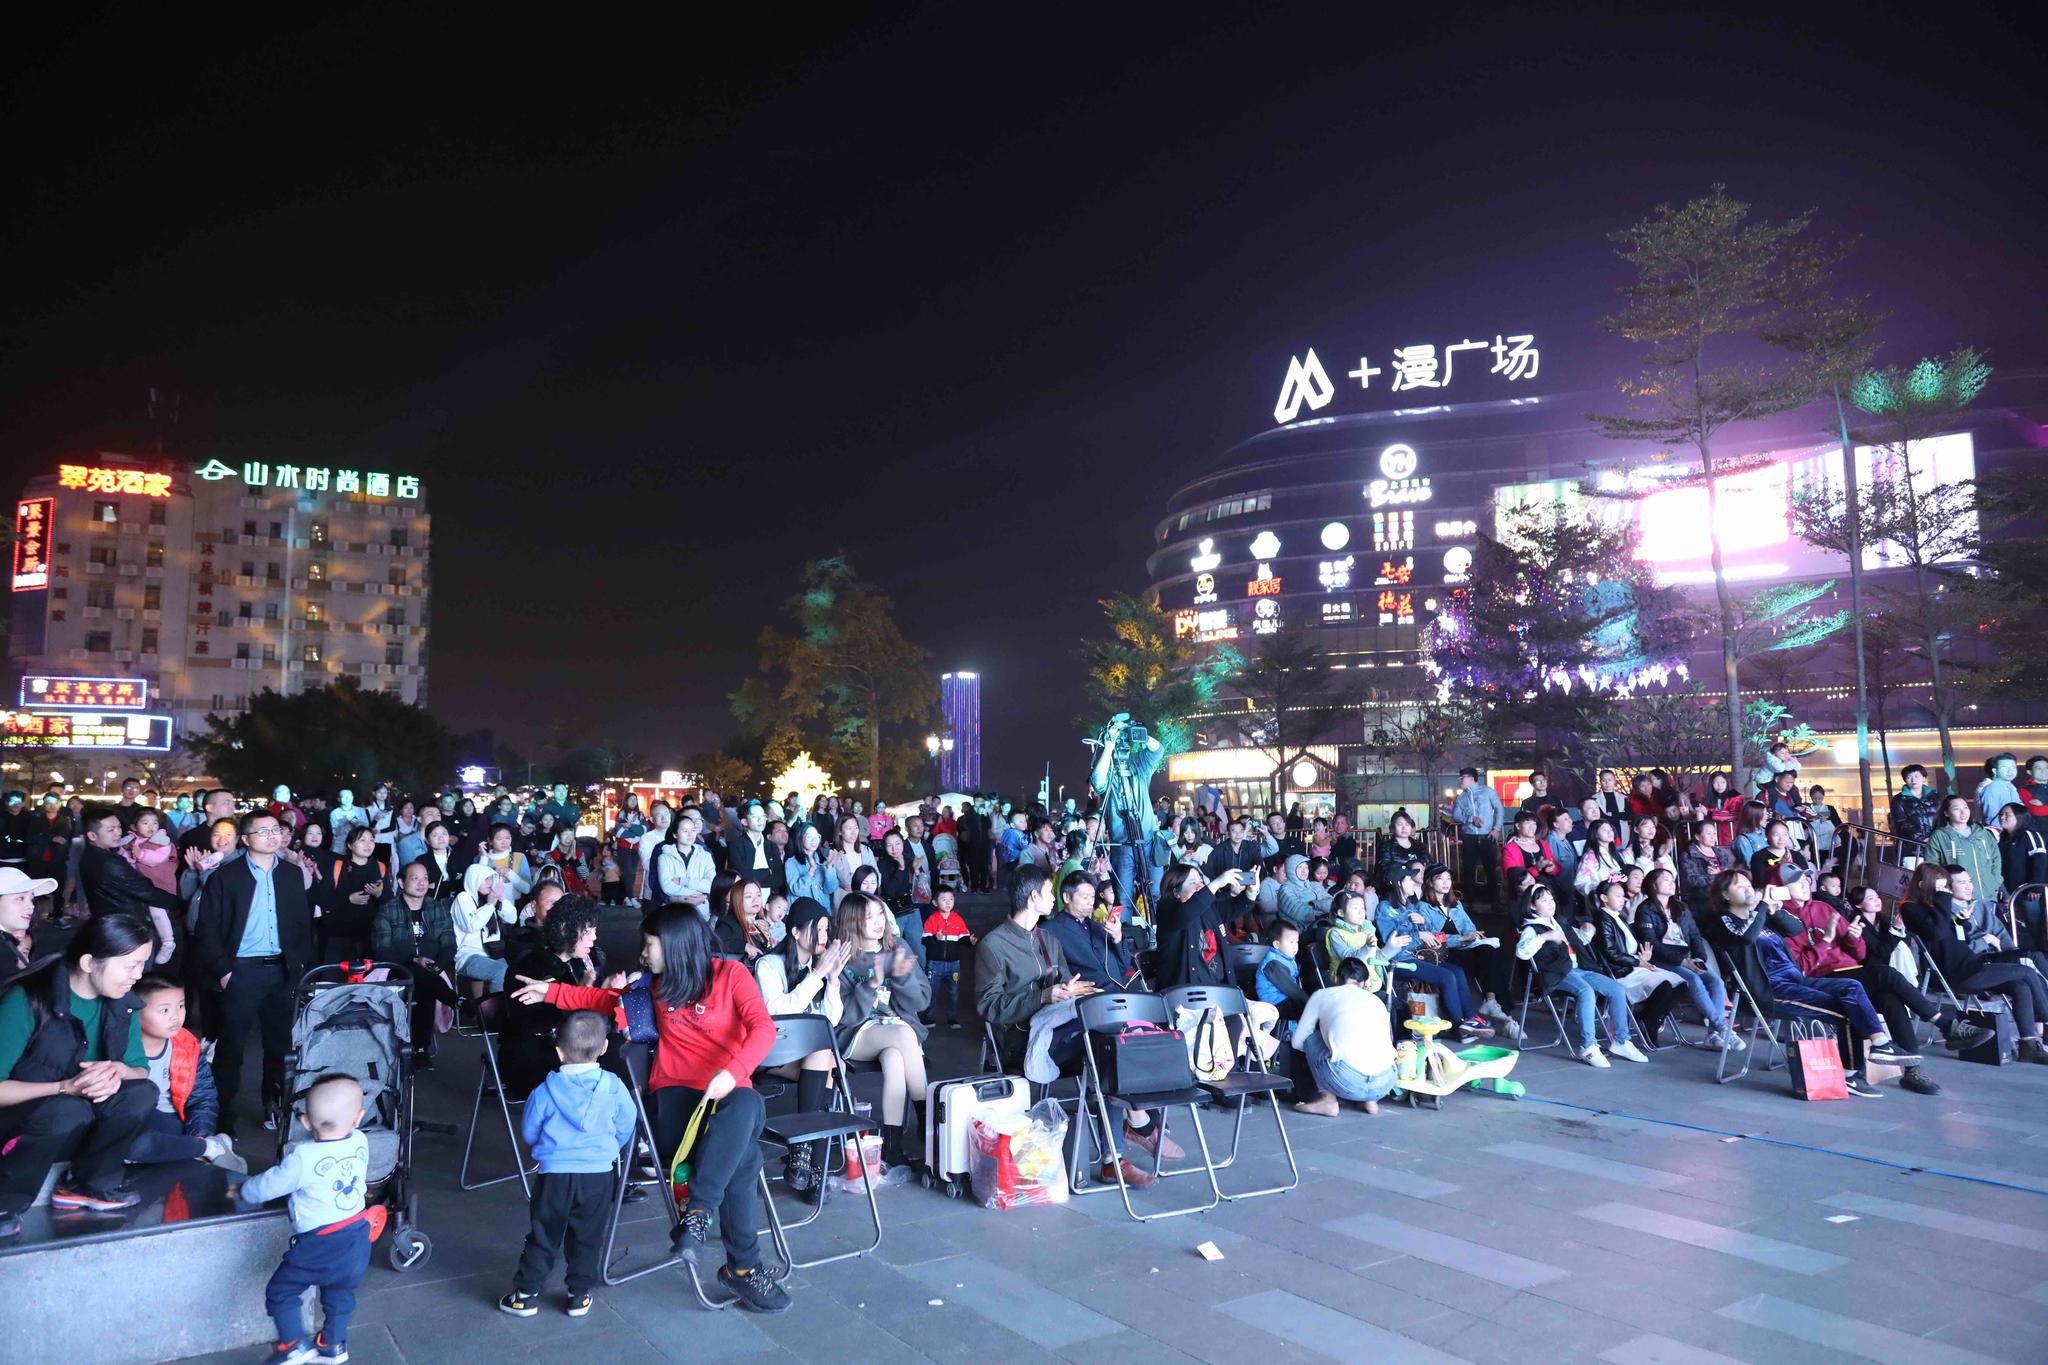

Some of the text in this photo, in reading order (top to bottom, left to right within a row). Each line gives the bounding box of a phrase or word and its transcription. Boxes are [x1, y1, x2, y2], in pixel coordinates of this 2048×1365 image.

[1391, 334, 1540, 392] 漫广场
[58, 464, 173, 498] 翠苑酒家
[243, 461, 420, 499] 山水时尚酒店
